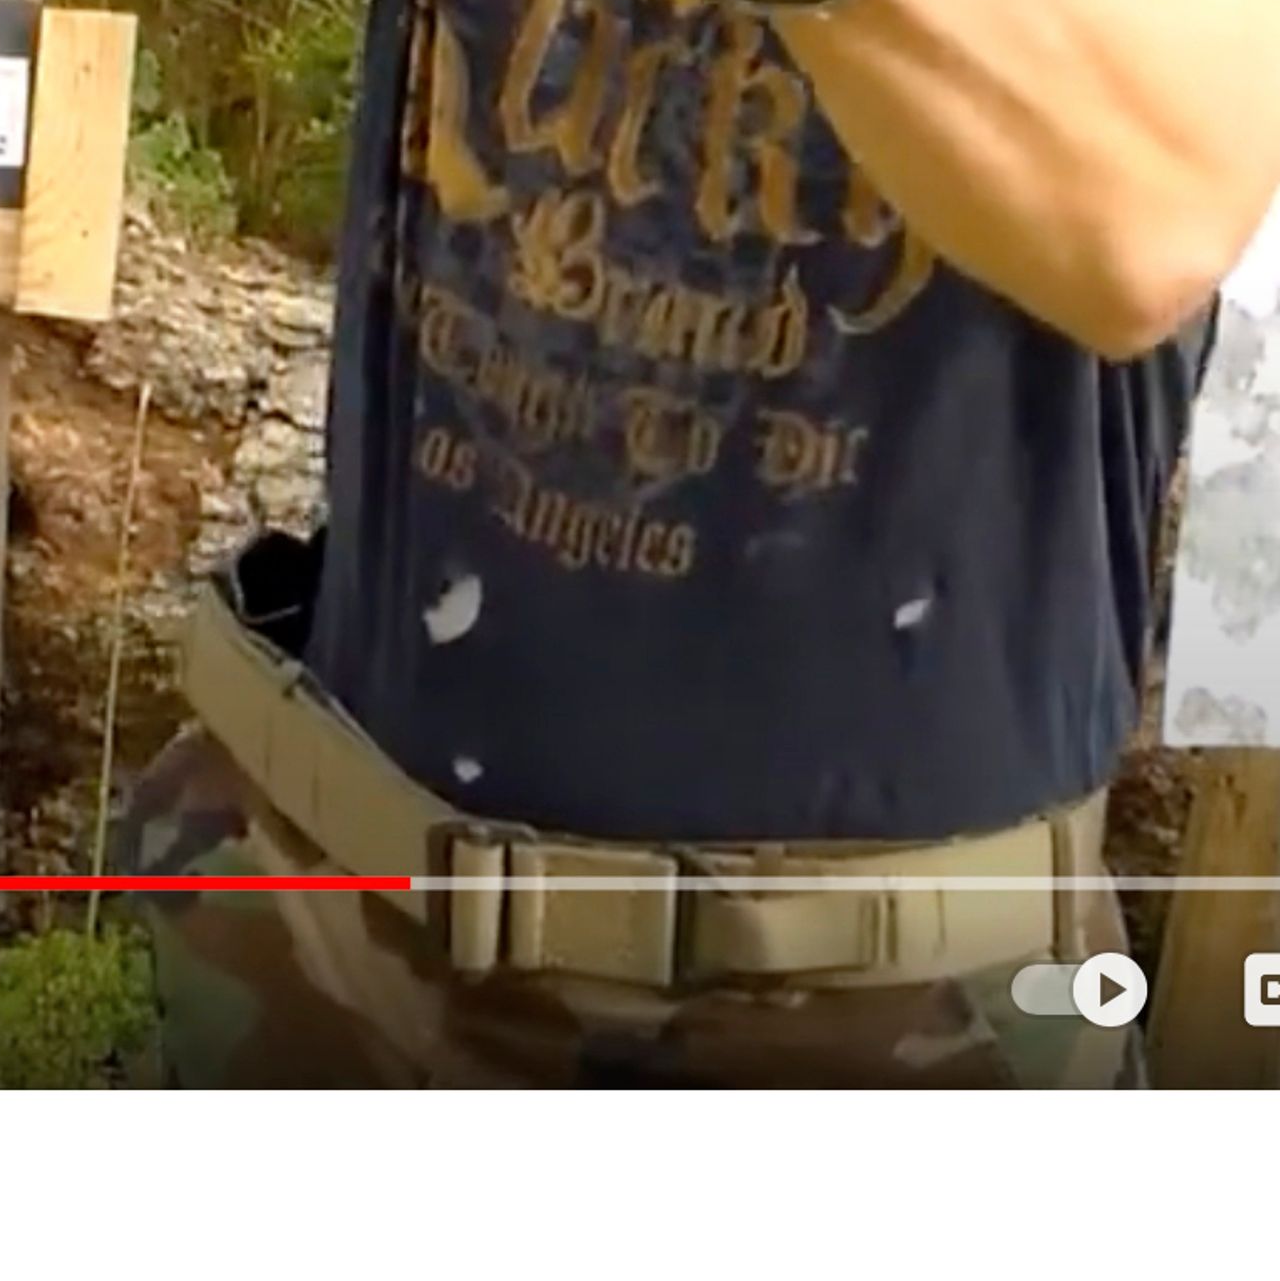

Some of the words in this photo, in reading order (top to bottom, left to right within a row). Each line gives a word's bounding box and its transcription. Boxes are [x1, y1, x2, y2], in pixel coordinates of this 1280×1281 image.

[509, 192, 807, 380] Brand
[421, 428, 477, 491] os
[492, 458, 697, 577] Angeles
[625, 387, 719, 484] To
